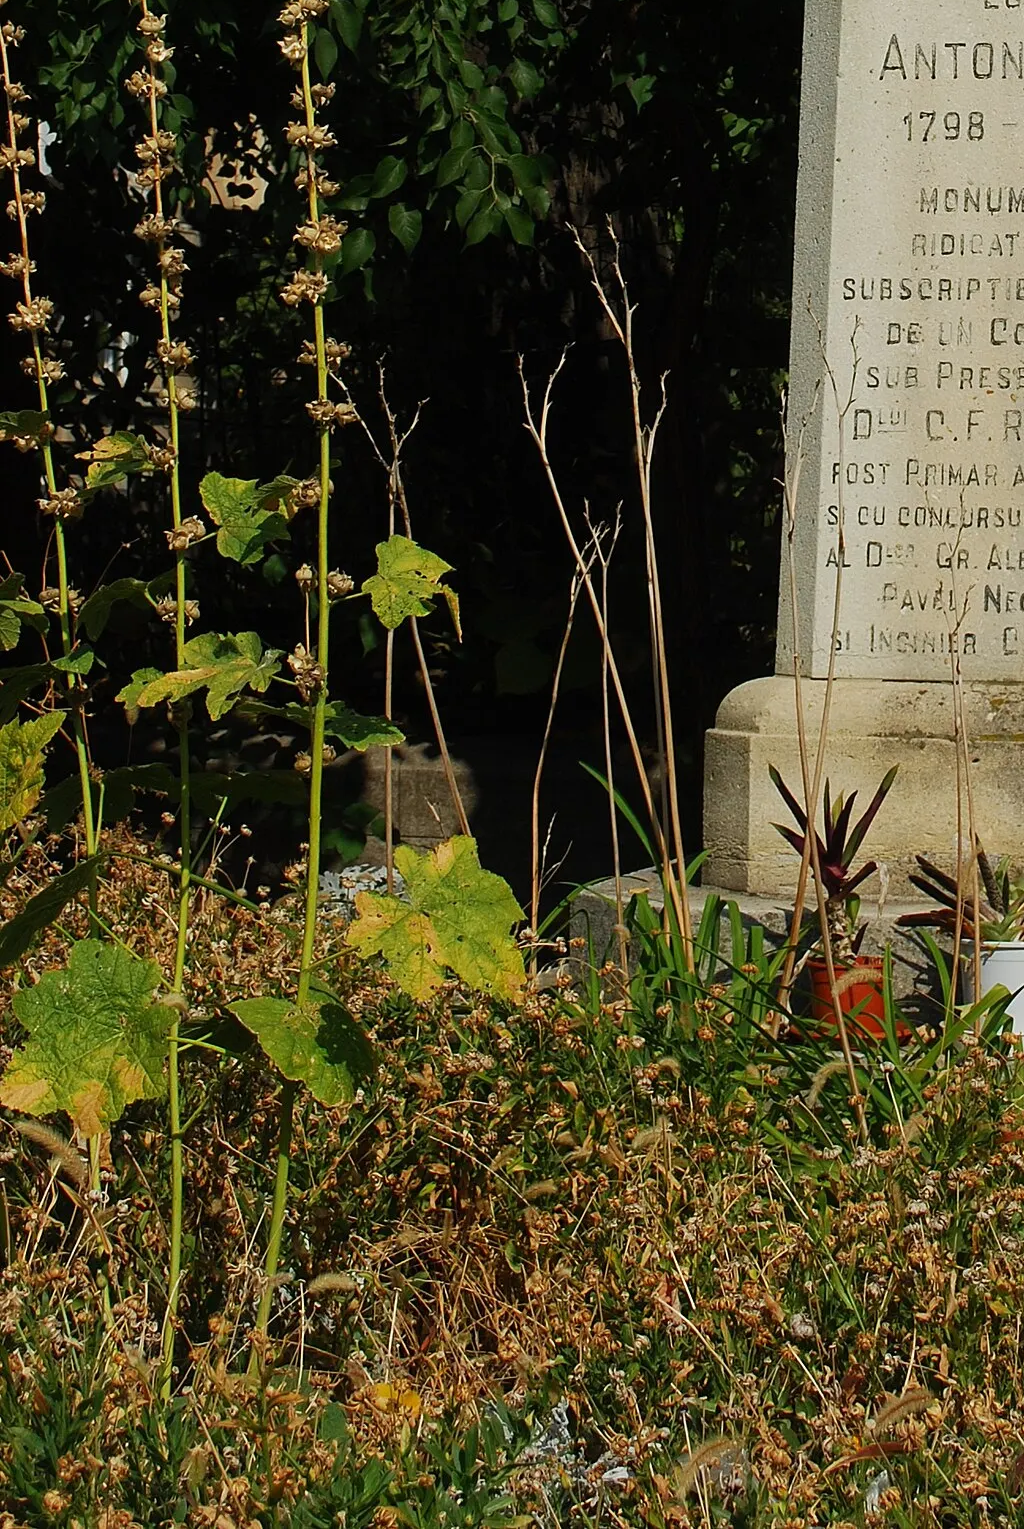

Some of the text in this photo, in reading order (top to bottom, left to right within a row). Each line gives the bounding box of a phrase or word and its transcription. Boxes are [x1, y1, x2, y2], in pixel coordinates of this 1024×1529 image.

[879, 33, 1024, 81] ANTON
[902, 110, 985, 142] 1798
[911, 232, 1019, 259] RIDICAT
[886, 322, 920, 346] DE
[938, 321, 973, 347] UN
[866, 366, 919, 390] SUB
[905, 458, 999, 489] PRIMAR
[858, 506, 886, 526] CU
[825, 547, 852, 568] AL
[882, 581, 957, 612] PAVEL
